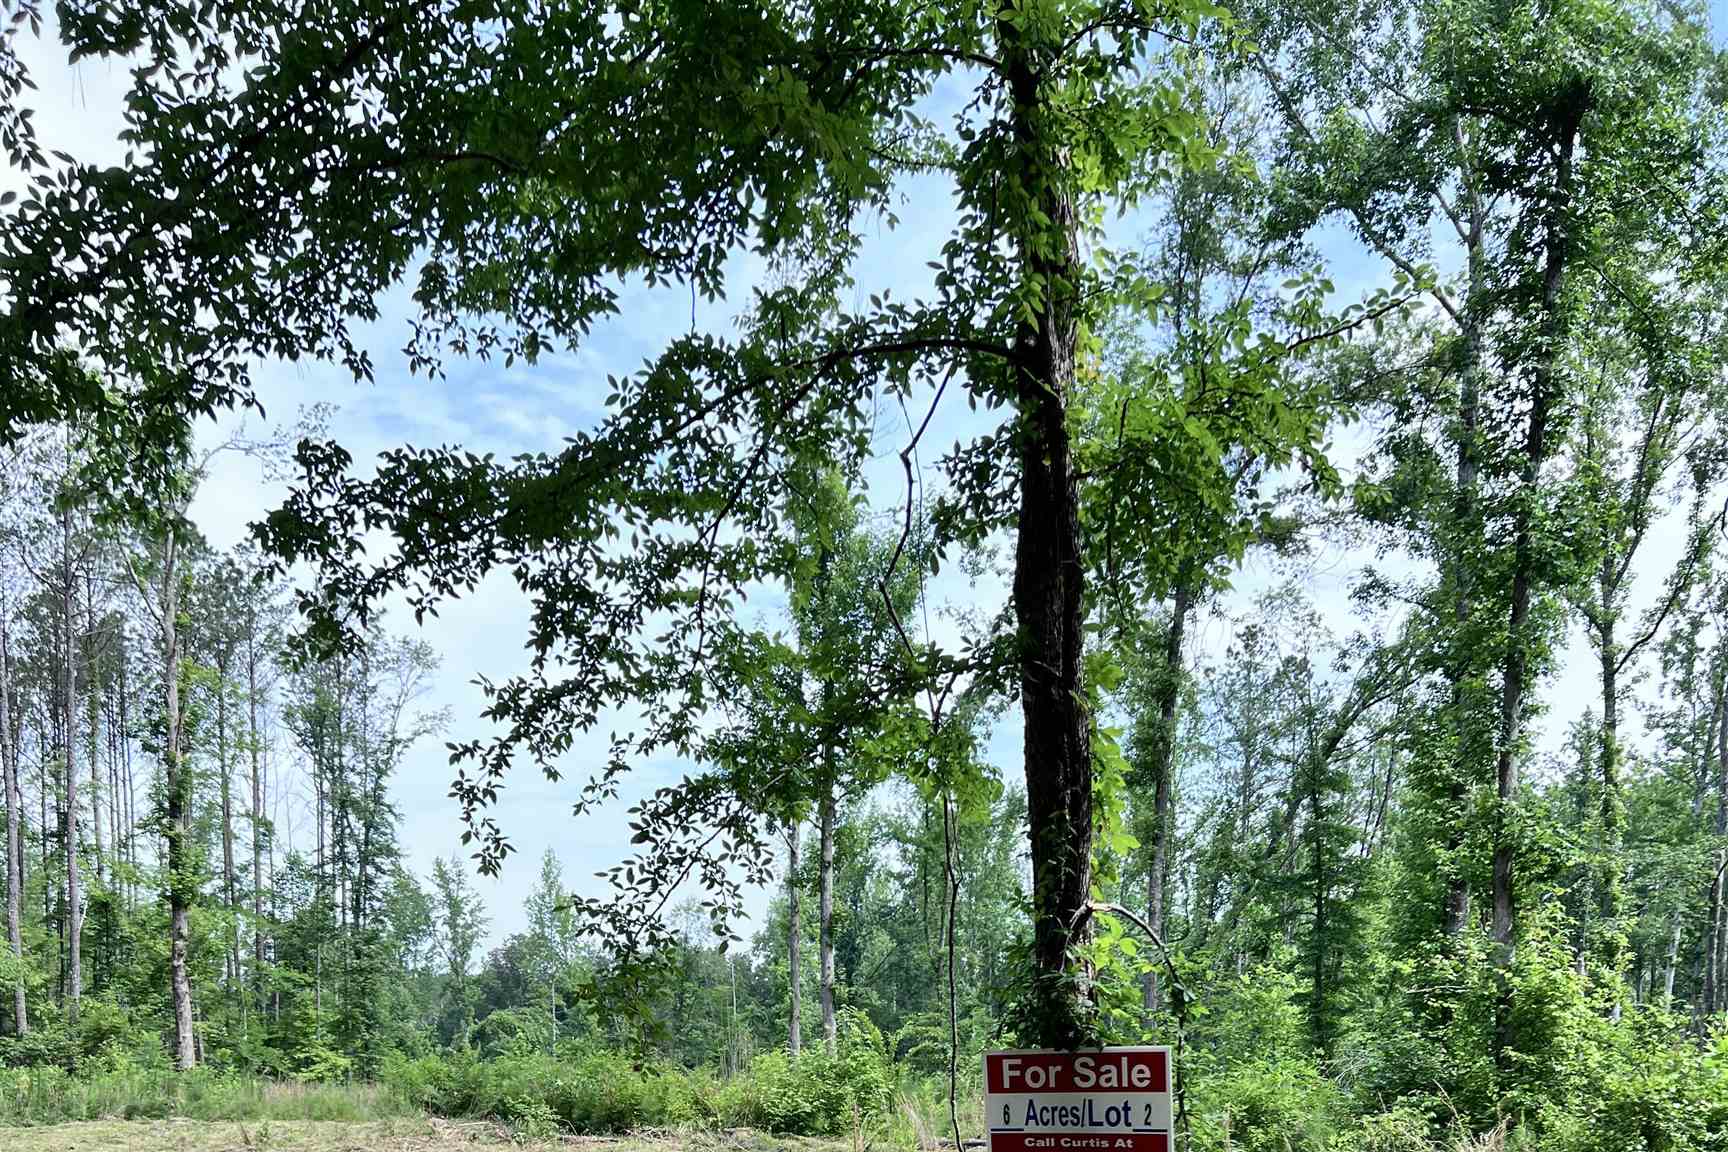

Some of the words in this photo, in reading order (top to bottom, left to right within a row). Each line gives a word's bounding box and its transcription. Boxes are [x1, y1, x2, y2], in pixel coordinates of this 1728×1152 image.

[1001, 1058, 1062, 1089] For
[1073, 1056, 1152, 1088] Sale
[1003, 1103, 1011, 1126] 6
[1024, 1097, 1132, 1128] Acres/Lot
[1144, 1103, 1152, 1126] 2
[1024, 1137, 1055, 1147] Call
[1060, 1137, 1110, 1148] Curtis
[1114, 1138, 1134, 1148] At
